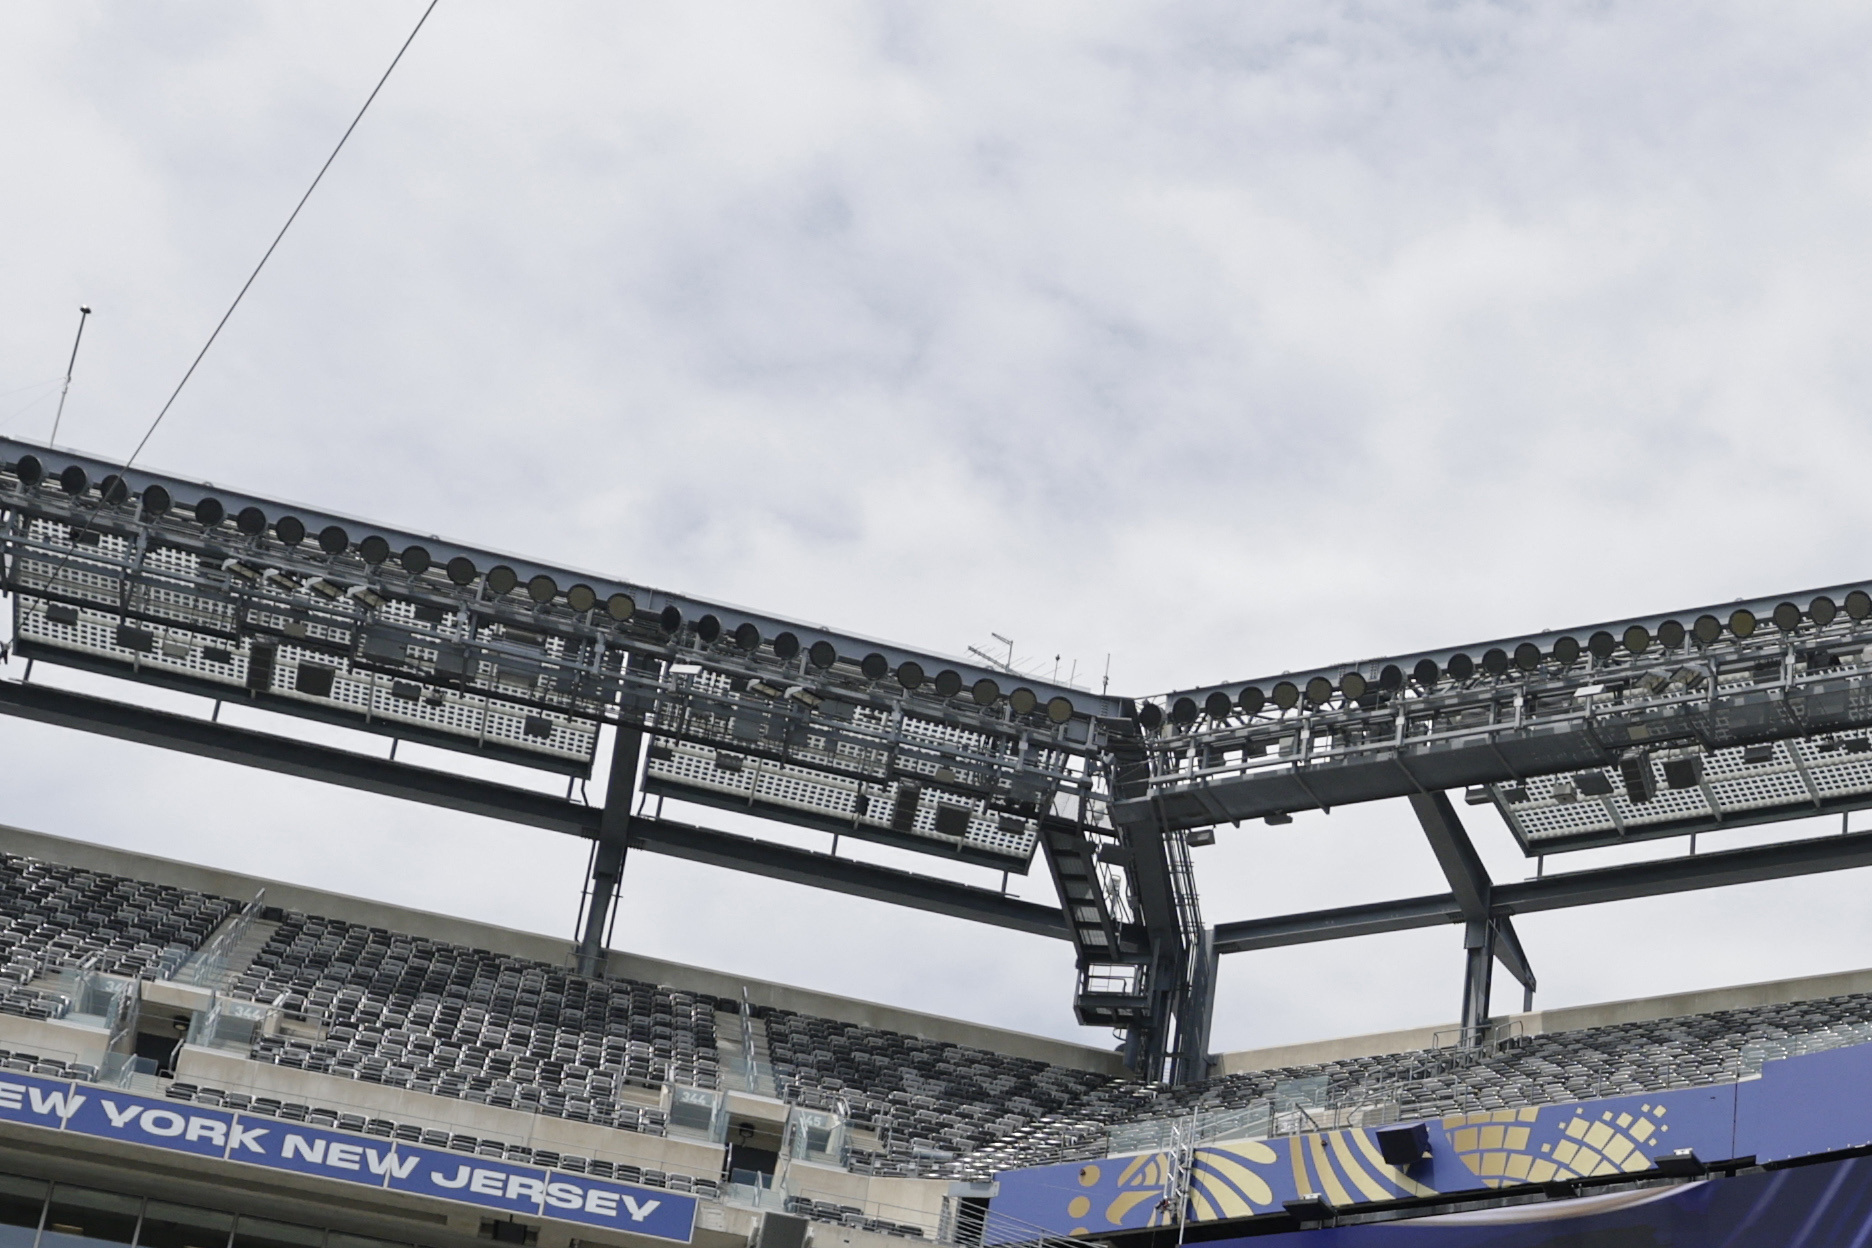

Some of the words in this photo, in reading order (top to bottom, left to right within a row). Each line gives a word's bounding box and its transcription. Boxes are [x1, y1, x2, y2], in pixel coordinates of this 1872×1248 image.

[682, 1090, 706, 1105] 344
[0, 1082, 87, 1119] EW
[101, 1100, 270, 1154] YORK
[281, 1133, 420, 1180] NEW
[430, 1164, 661, 1222] JERSEY
